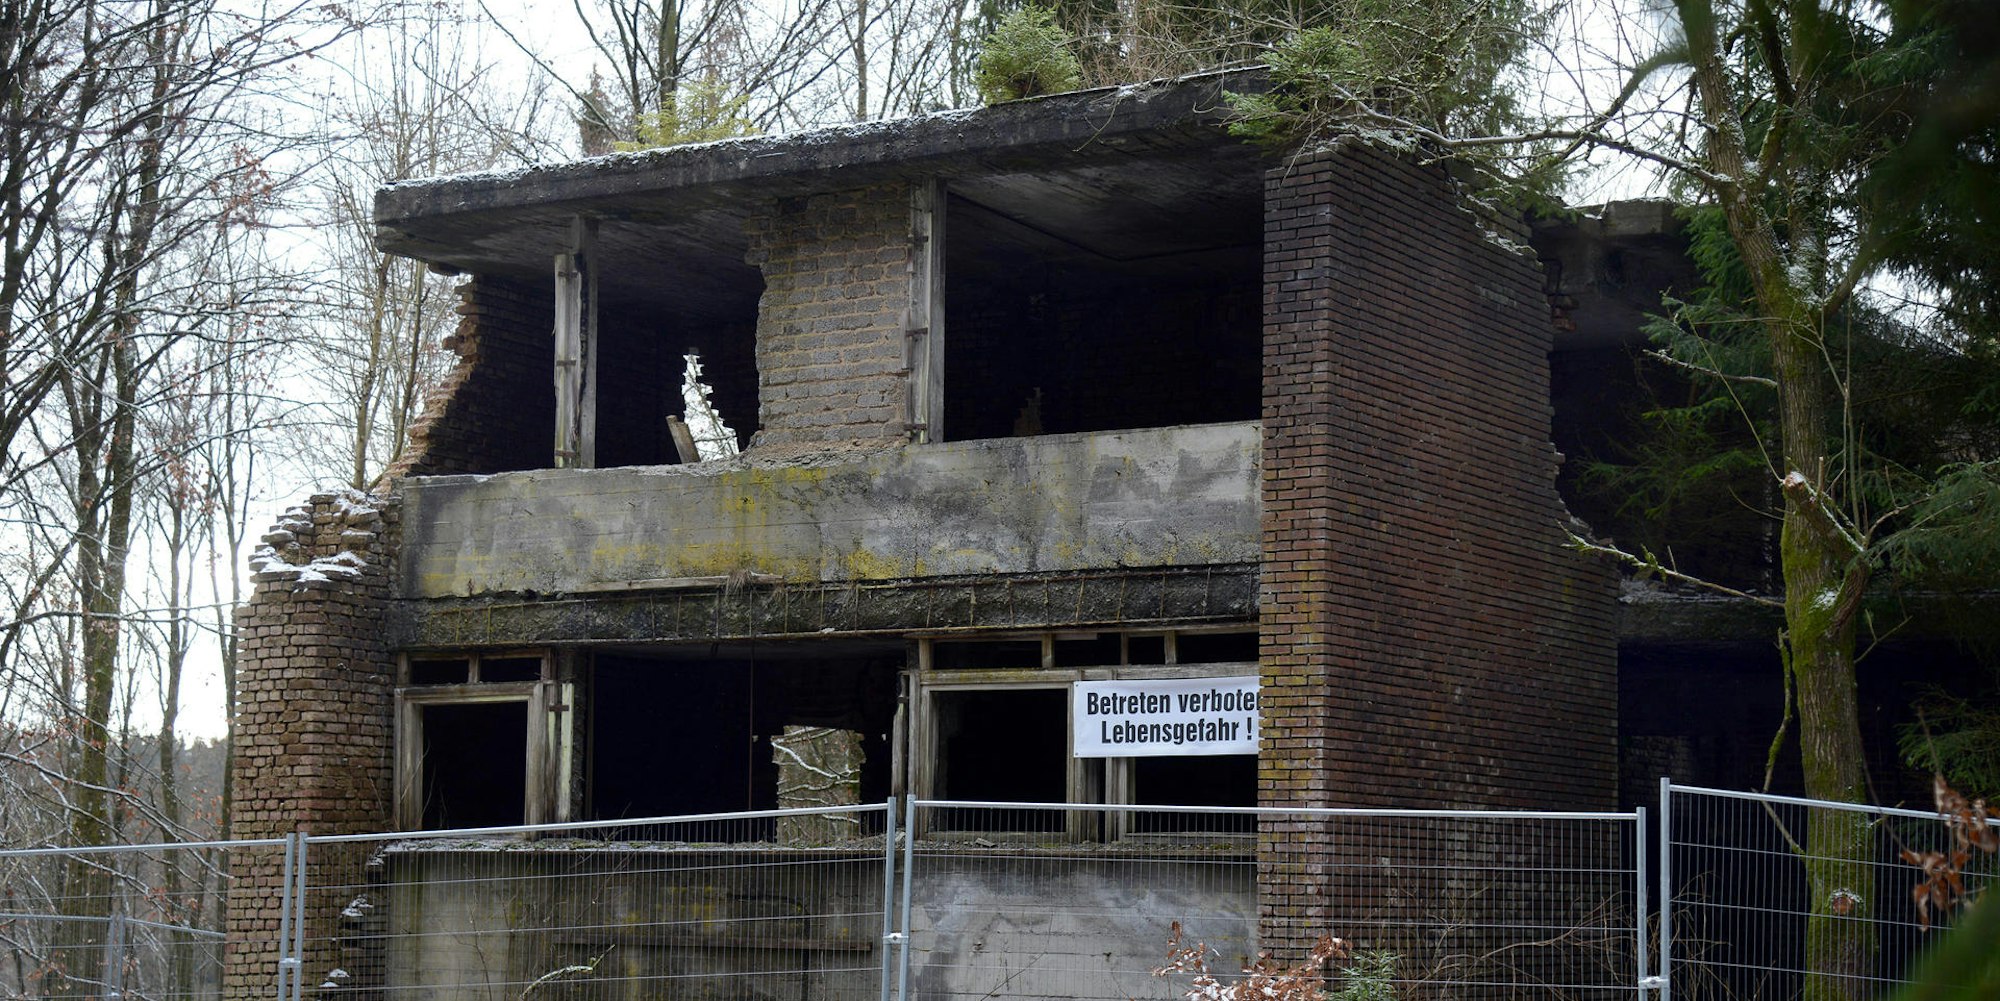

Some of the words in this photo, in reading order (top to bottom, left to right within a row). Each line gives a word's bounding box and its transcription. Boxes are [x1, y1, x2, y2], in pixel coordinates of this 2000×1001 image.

[1087, 692, 1170, 715] Betreten
[1101, 718, 1239, 745] Lebensgefahr
[1246, 717, 1252, 741] !
